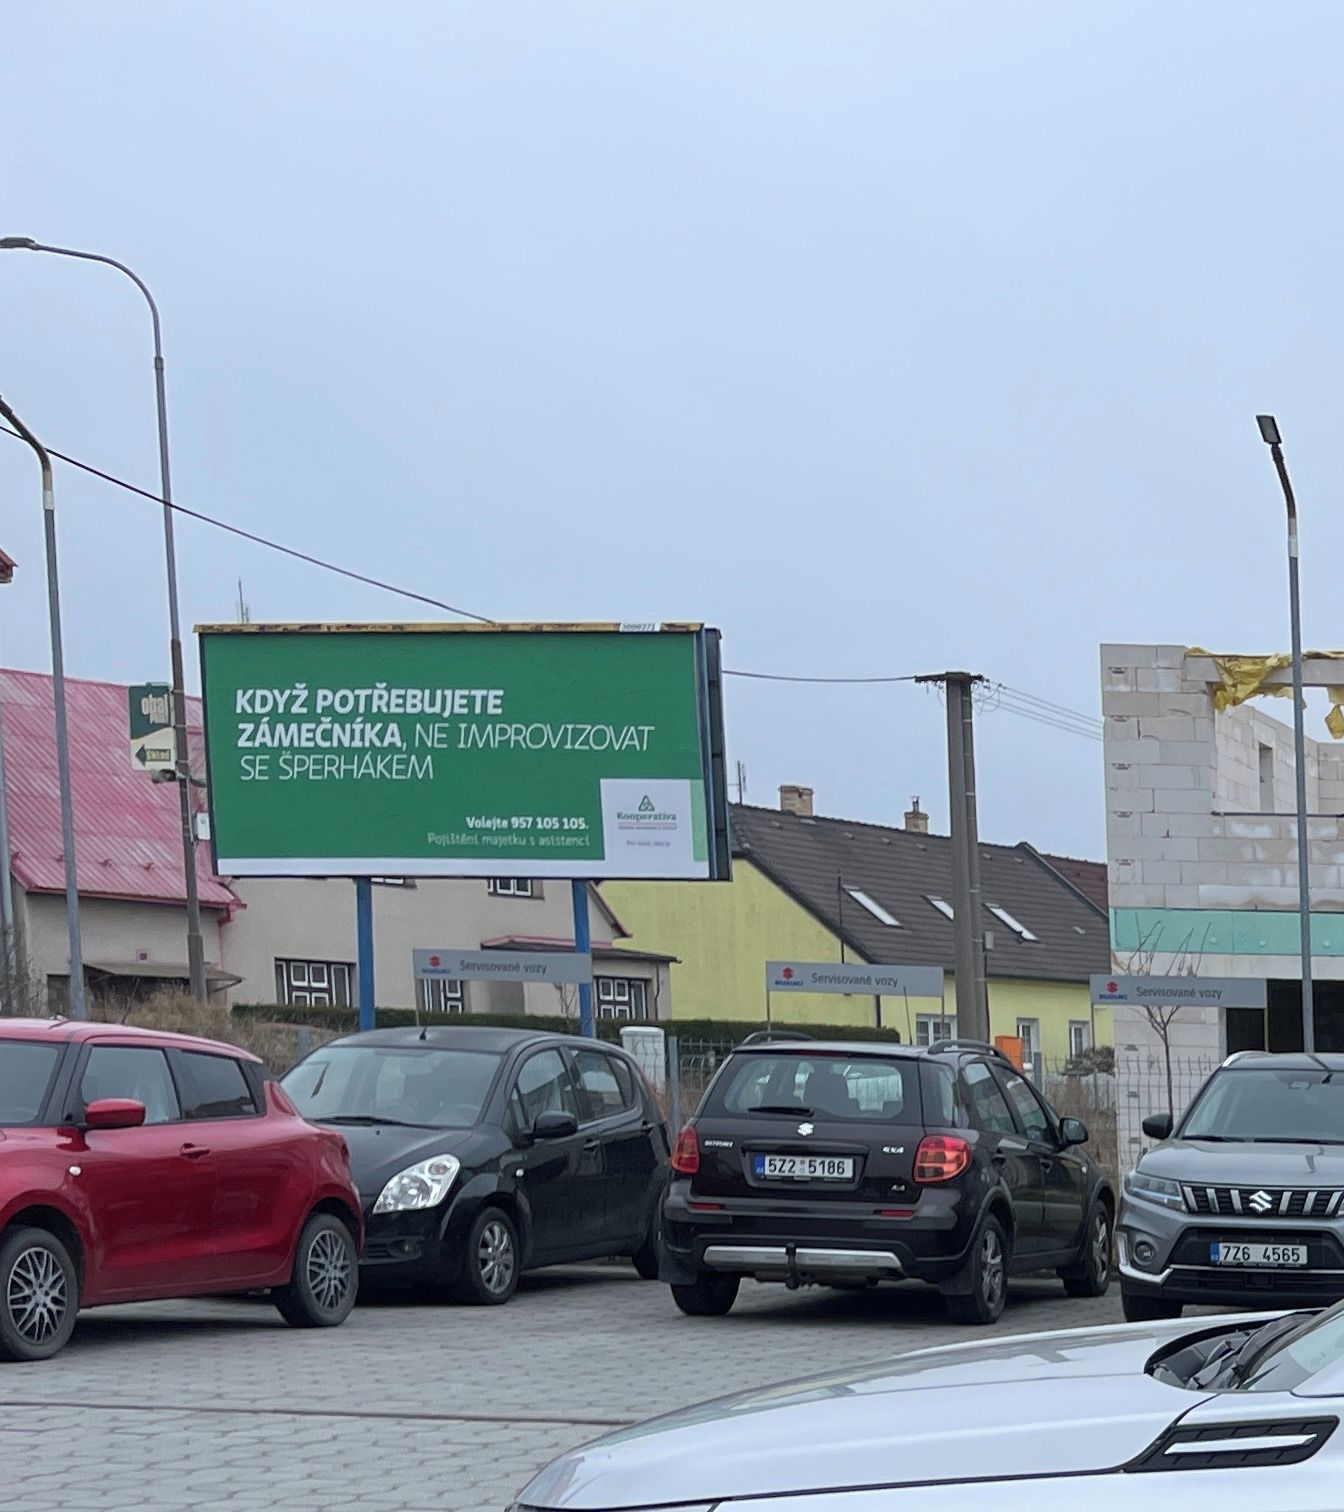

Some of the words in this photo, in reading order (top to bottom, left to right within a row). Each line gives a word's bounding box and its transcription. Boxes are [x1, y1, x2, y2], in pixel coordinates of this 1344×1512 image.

[235, 682, 309, 714] KDYŽ
[315, 682, 504, 718] POTŘEBUJETE
[237, 716, 407, 751] ZÁMEČNÍKA,
[415, 723, 450, 749] NE
[457, 722, 656, 751] IMPROVIZOVAT
[240, 754, 270, 780] SE
[278, 751, 434, 780] ŠPERHÁKEM
[465, 816, 508, 831] Volejte
[510, 816, 533, 829] 957
[536, 816, 560, 830] 105
[459, 959, 521, 974] Servisované
[523, 964, 547, 976] vozy
[811, 972, 872, 986] Servisované
[875, 977, 899, 988] vozy
[1136, 986, 1196, 999] Servisované
[1198, 990, 1222, 1000] vozy
[768, 1158, 796, 1174] 5Z2
[808, 1159, 846, 1175] 5186
[1222, 1245, 1250, 1261] 7Z6
[1262, 1246, 1300, 1262] 4565
